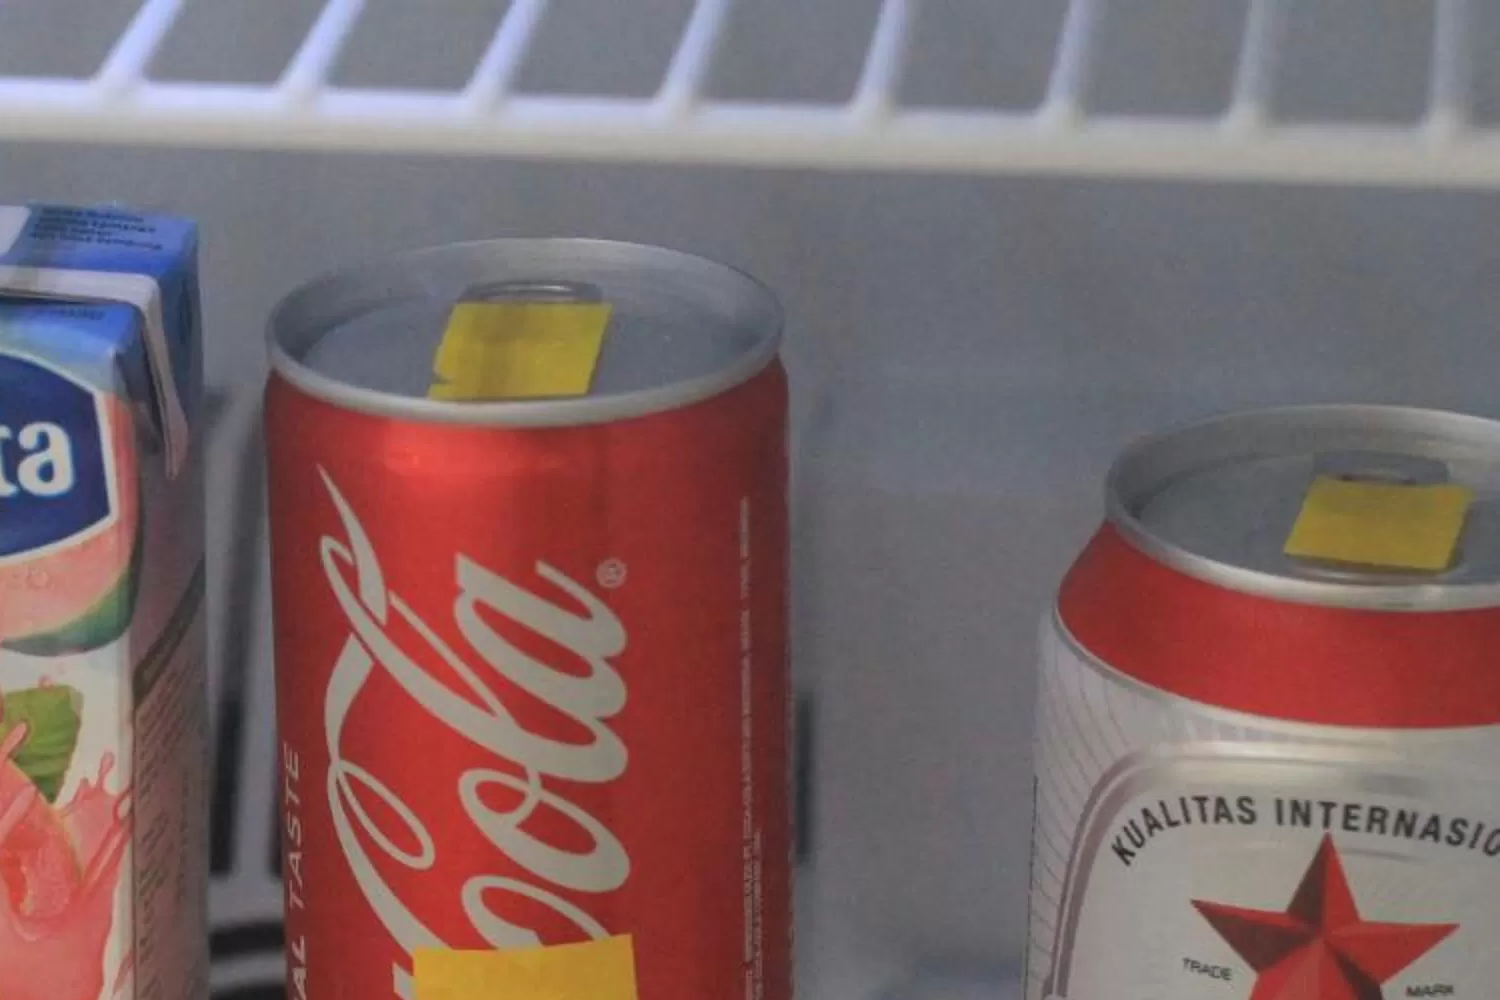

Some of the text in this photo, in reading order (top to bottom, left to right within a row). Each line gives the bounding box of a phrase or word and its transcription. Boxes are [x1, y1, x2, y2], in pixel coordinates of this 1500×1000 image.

[283, 741, 305, 912] TASTE
[1111, 796, 1258, 867] KUALITAS
[1182, 956, 1233, 982] TRADE
